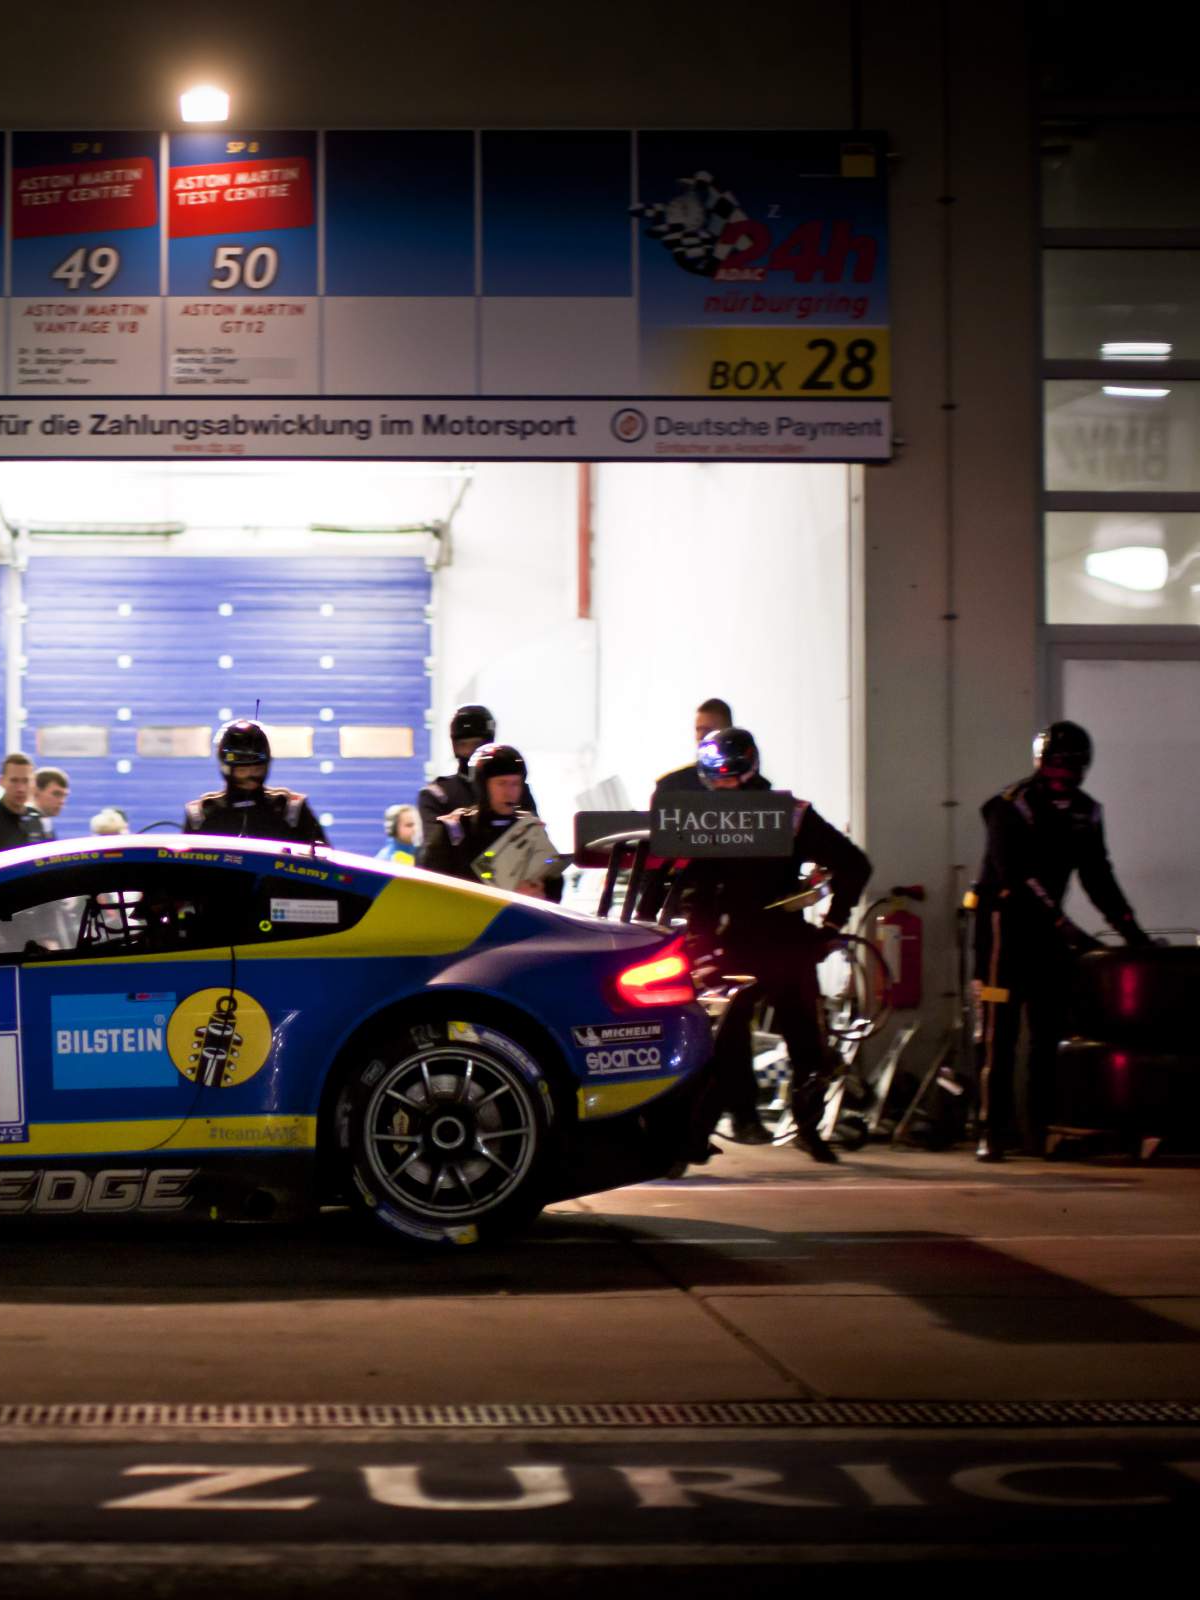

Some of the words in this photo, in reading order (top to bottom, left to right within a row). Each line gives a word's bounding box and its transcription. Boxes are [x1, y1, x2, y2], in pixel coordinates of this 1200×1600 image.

[18, 175, 73, 190] ASTON
[79, 169, 143, 185] MARTIN
[174, 175, 229, 190] ASTON
[234, 168, 301, 184] MARTIN
[21, 190, 62, 205] TEST
[68, 184, 133, 201] CENTRE
[177, 190, 218, 205] TEST
[224, 184, 291, 201] CENTRE
[51, 246, 120, 291] 49
[209, 245, 279, 290] 50
[23, 304, 79, 317] ASTON
[84, 303, 148, 316] MARTIN
[180, 304, 236, 317] ASTON
[241, 303, 306, 316] MARTIN
[703, 293, 870, 319] nürburgring
[34, 321, 110, 334] VANTAGE
[220, 320, 265, 334] GT12
[709, 360, 789, 391] BOX
[800, 338, 877, 392] 28
[41, 414, 81, 436] die
[89, 413, 371, 441] Zahlungsabwicklung
[381, 414, 413, 435] im
[423, 413, 577, 440] Motorsport
[654, 415, 770, 438] Deutsche
[775, 414, 884, 441] Payment
[657, 807, 786, 831] HACKETT
[690, 832, 756, 846] LONDON
[274, 860, 330, 881] P.Lamy
[56, 1027, 163, 1055] BILSTEIN
[600, 1024, 662, 1041] MICHELIN
[585, 1047, 661, 1071] sparco
[96, 1460, 1200, 1512] ZURIC
